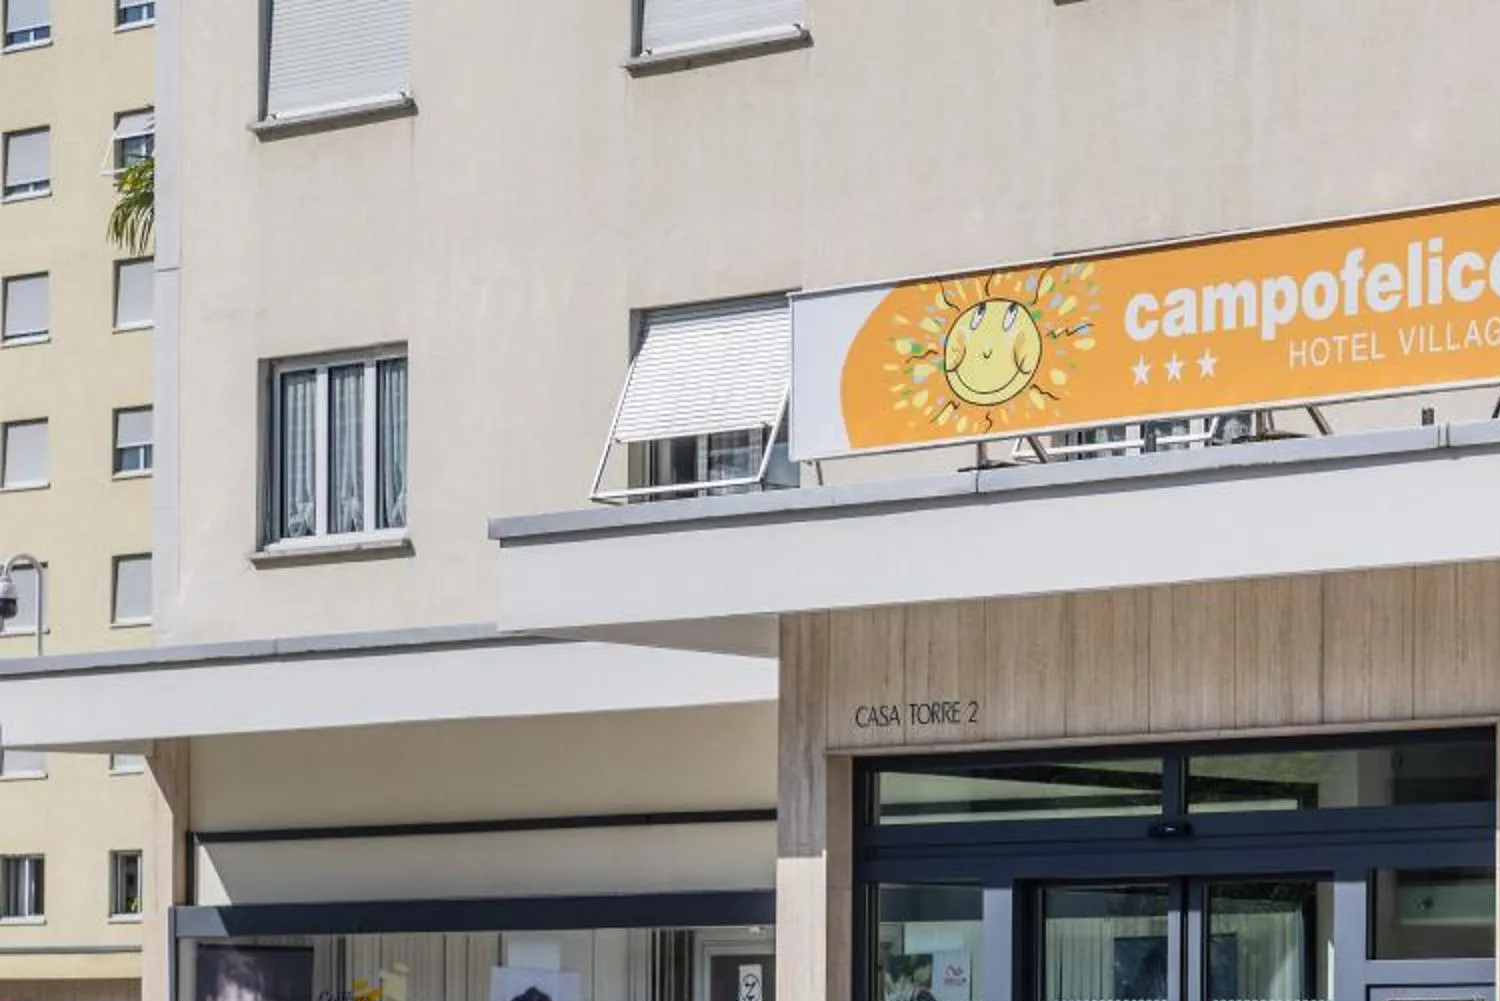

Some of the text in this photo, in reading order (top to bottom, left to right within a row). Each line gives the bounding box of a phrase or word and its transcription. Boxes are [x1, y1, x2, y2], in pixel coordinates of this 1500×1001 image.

[1288, 332, 1386, 369] HOTEL
[855, 701, 979, 728] CASA TORRE 2
